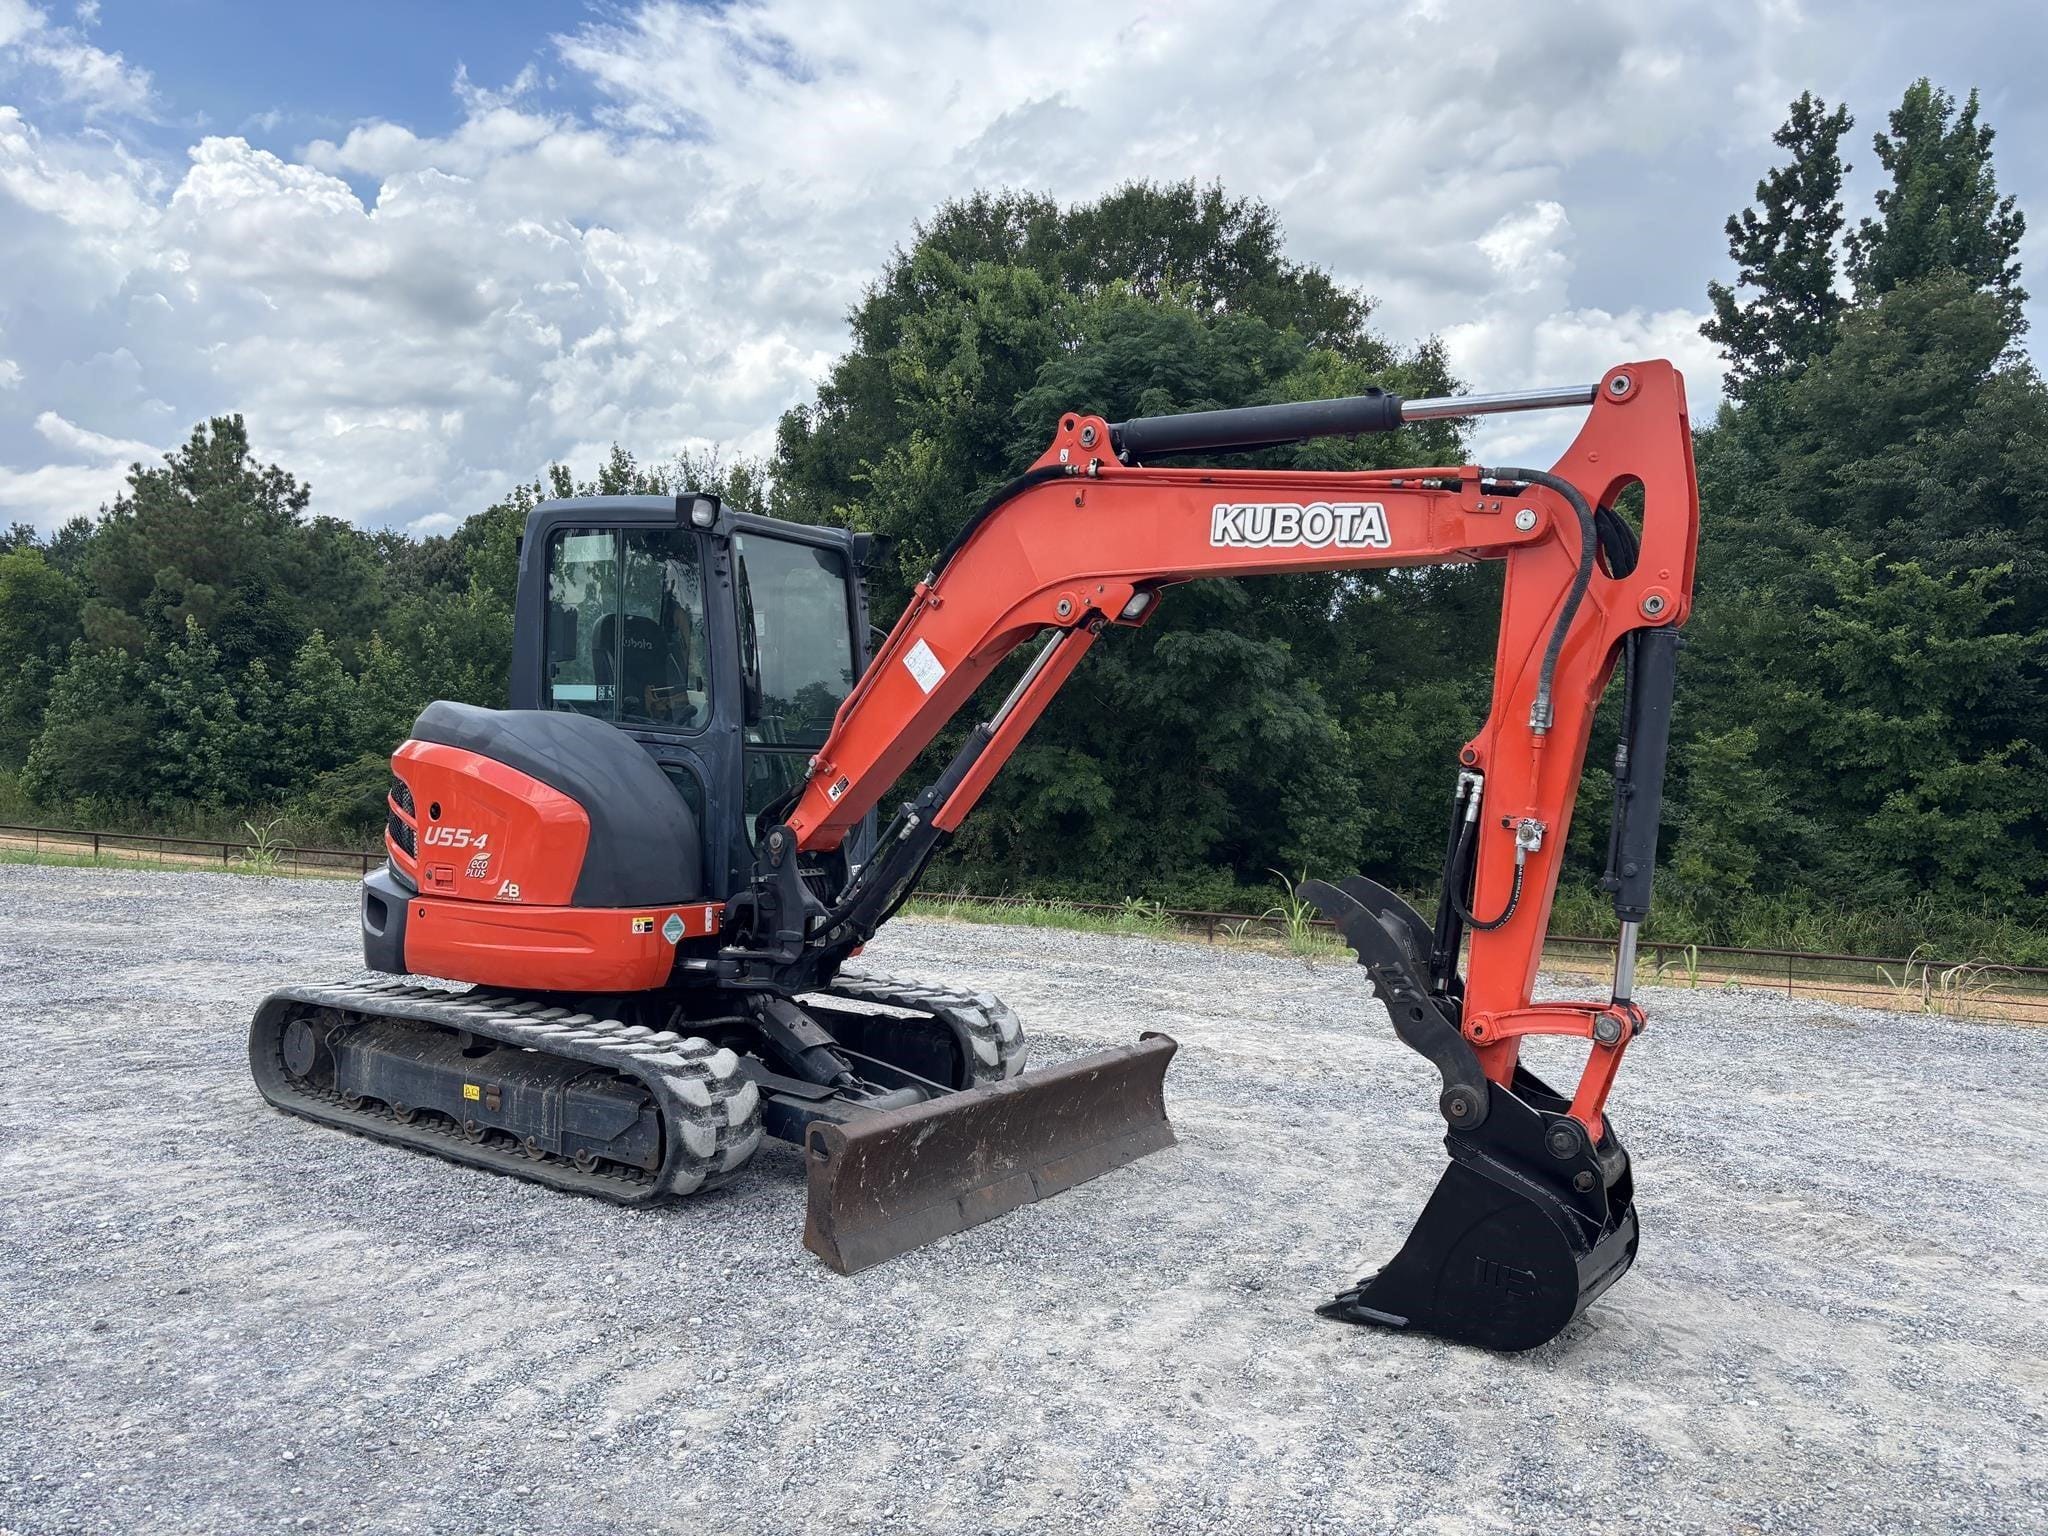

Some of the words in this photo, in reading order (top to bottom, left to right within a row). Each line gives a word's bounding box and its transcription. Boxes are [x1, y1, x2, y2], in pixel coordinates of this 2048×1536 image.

[1211, 503, 1389, 546] KUBOTA
[622, 638, 653, 650] ubota
[424, 826, 489, 849] U55-4
[471, 860, 488, 869] eco
[464, 868, 487, 878] PLUS
[497, 879, 519, 897] AB
